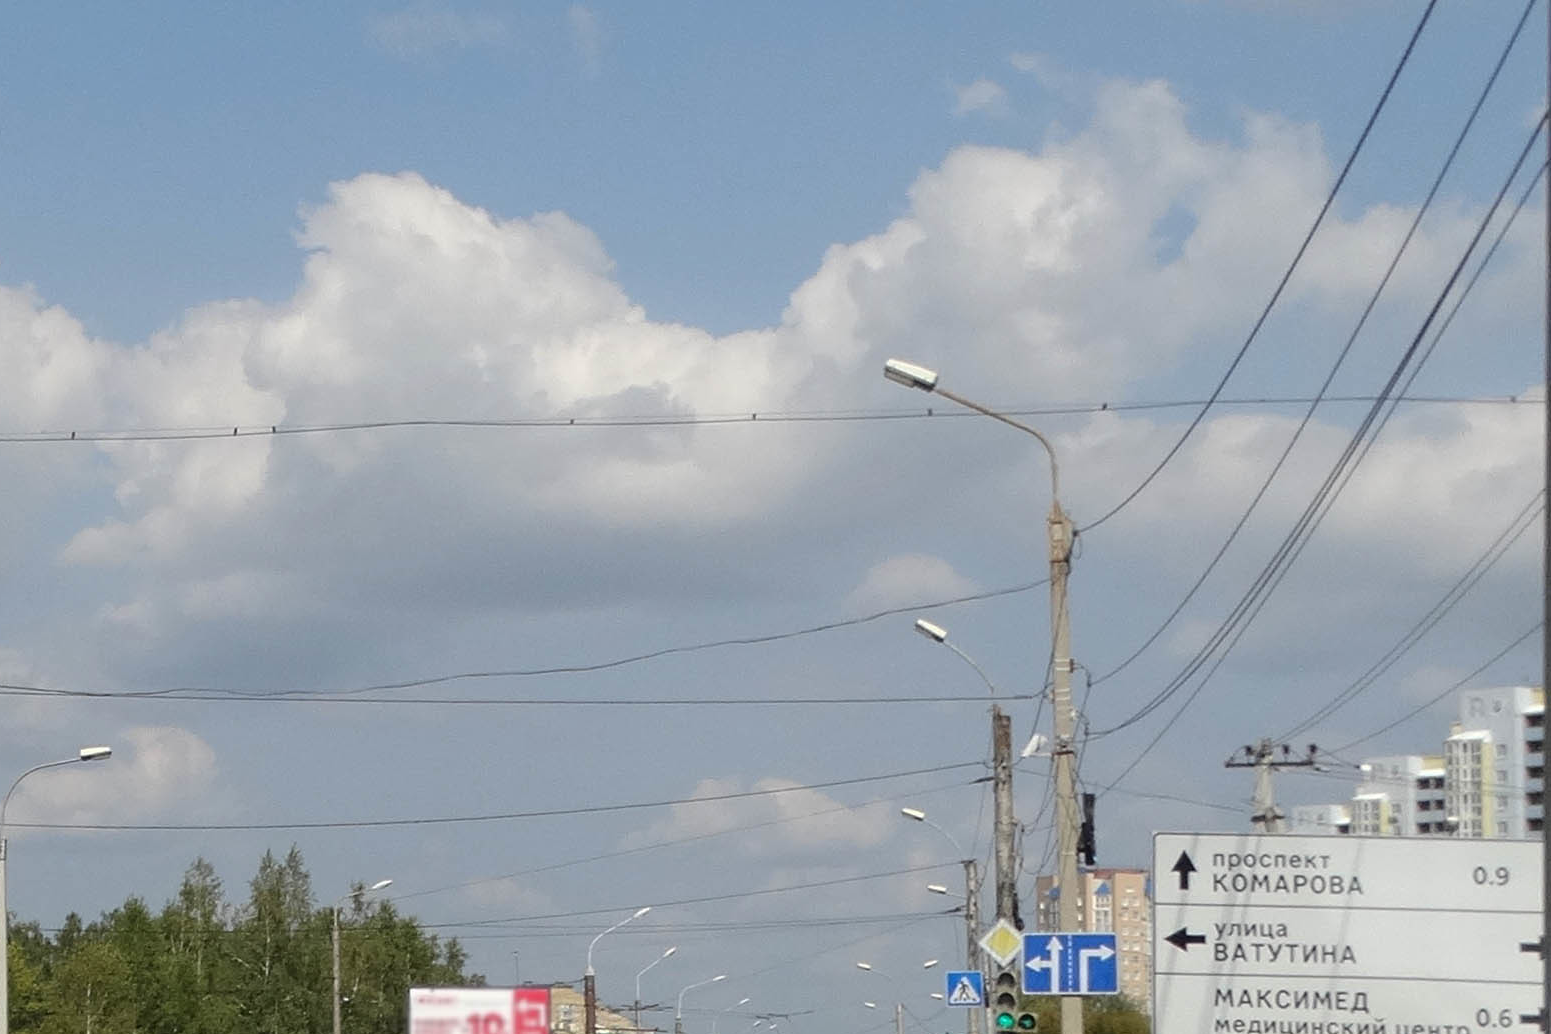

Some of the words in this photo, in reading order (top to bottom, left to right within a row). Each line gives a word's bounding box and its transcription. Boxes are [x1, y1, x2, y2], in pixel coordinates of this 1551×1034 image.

[1213, 852, 1330, 870] проспект
[1213, 874, 1363, 896] КОМАРОВА
[1473, 866, 1510, 886] 0.9
[1214, 921, 1289, 939] улица
[1214, 943, 1357, 964] ВАТУТИНА
[1214, 989, 1369, 1013] МАКСИМЕД
[1476, 1008, 1513, 1028] 0.6
